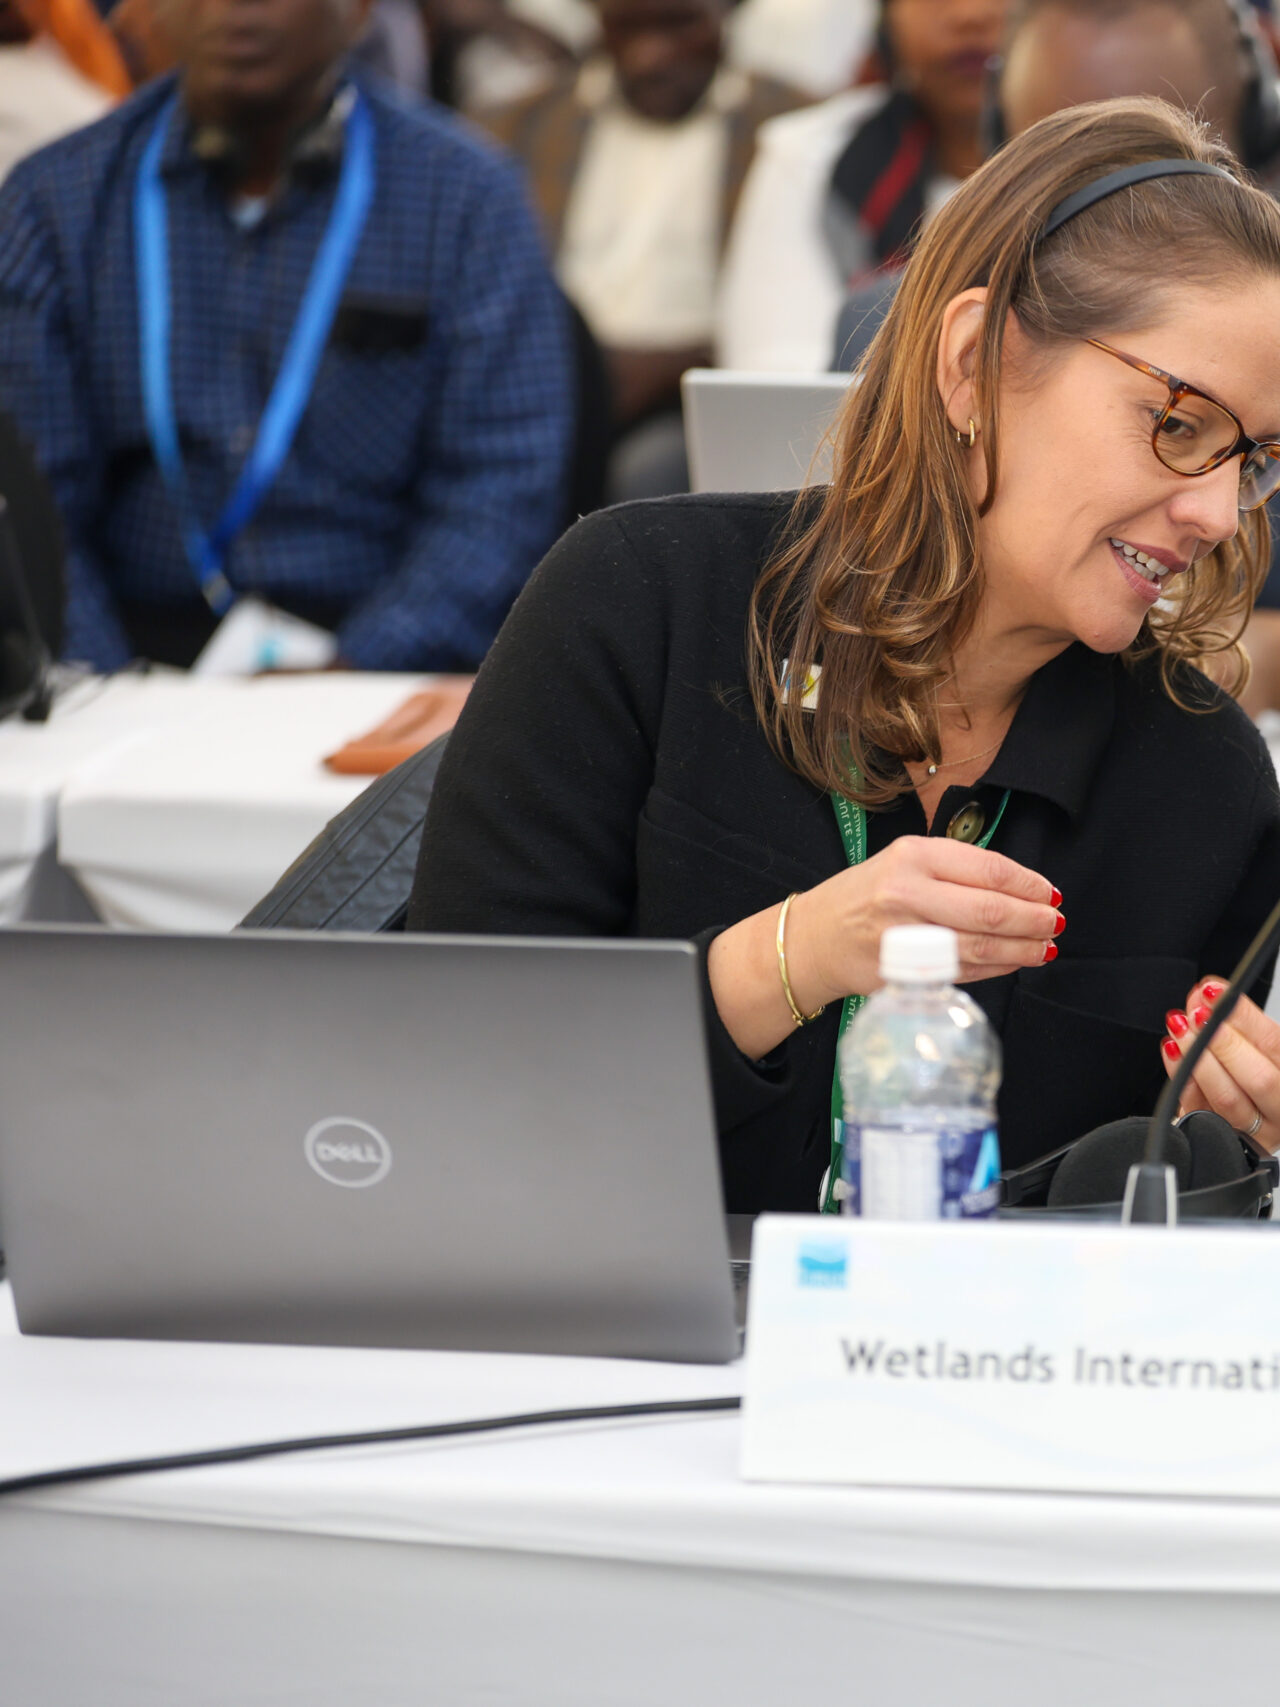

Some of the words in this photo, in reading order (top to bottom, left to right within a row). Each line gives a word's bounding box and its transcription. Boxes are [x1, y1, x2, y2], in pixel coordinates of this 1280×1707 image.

[838, 799, 850, 820] JUL
[843, 821, 854, 837] 31
[840, 1338, 1055, 1384] Wetlands
